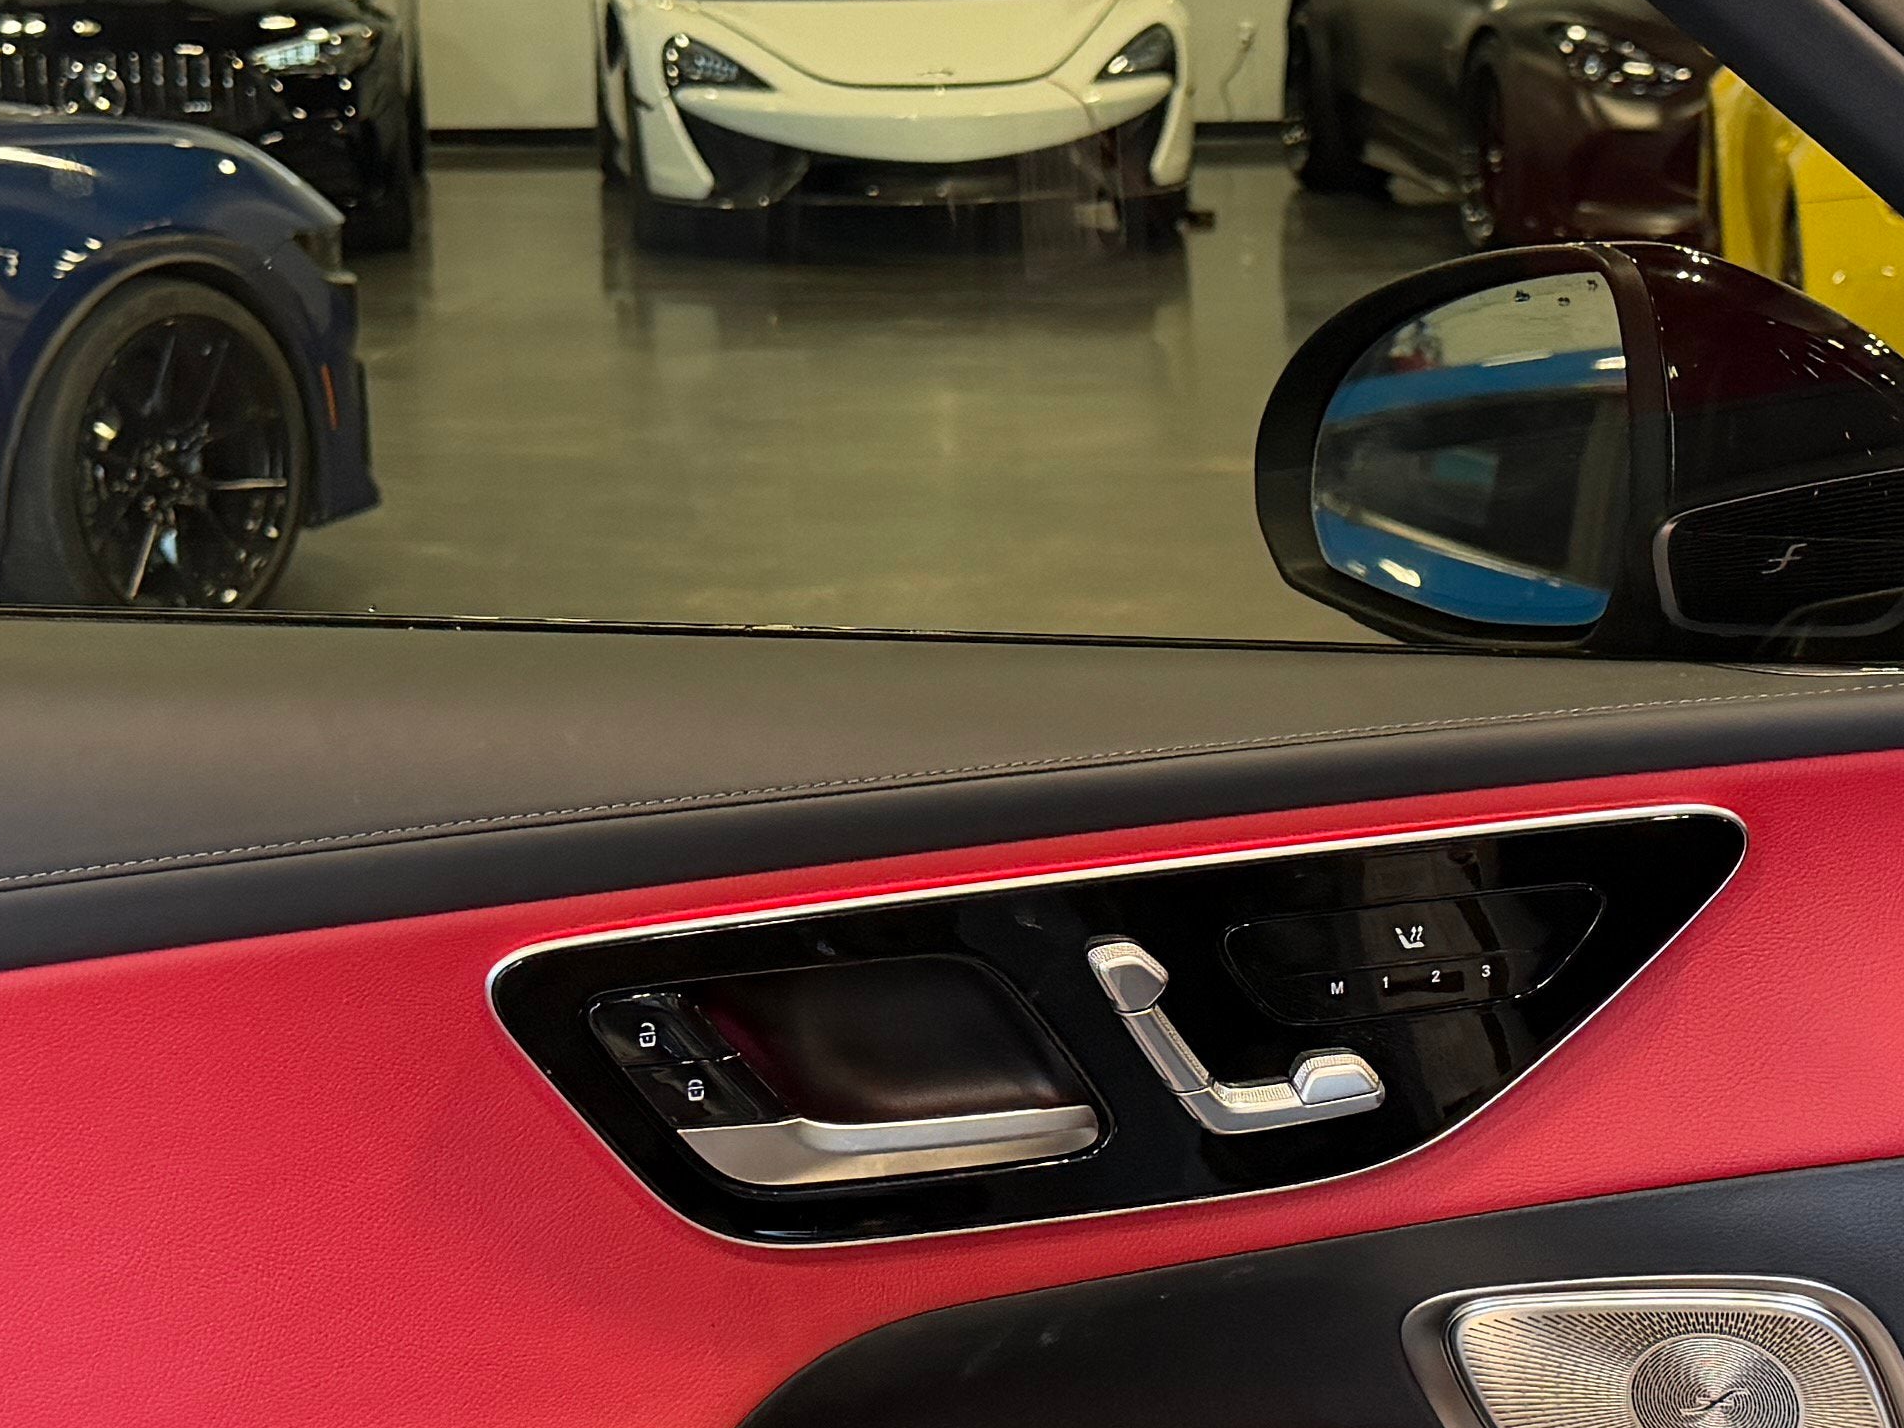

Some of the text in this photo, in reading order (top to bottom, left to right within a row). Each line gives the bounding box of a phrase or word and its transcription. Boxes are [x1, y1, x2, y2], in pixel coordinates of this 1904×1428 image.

[1330, 964, 1491, 995] M 1 2 3
